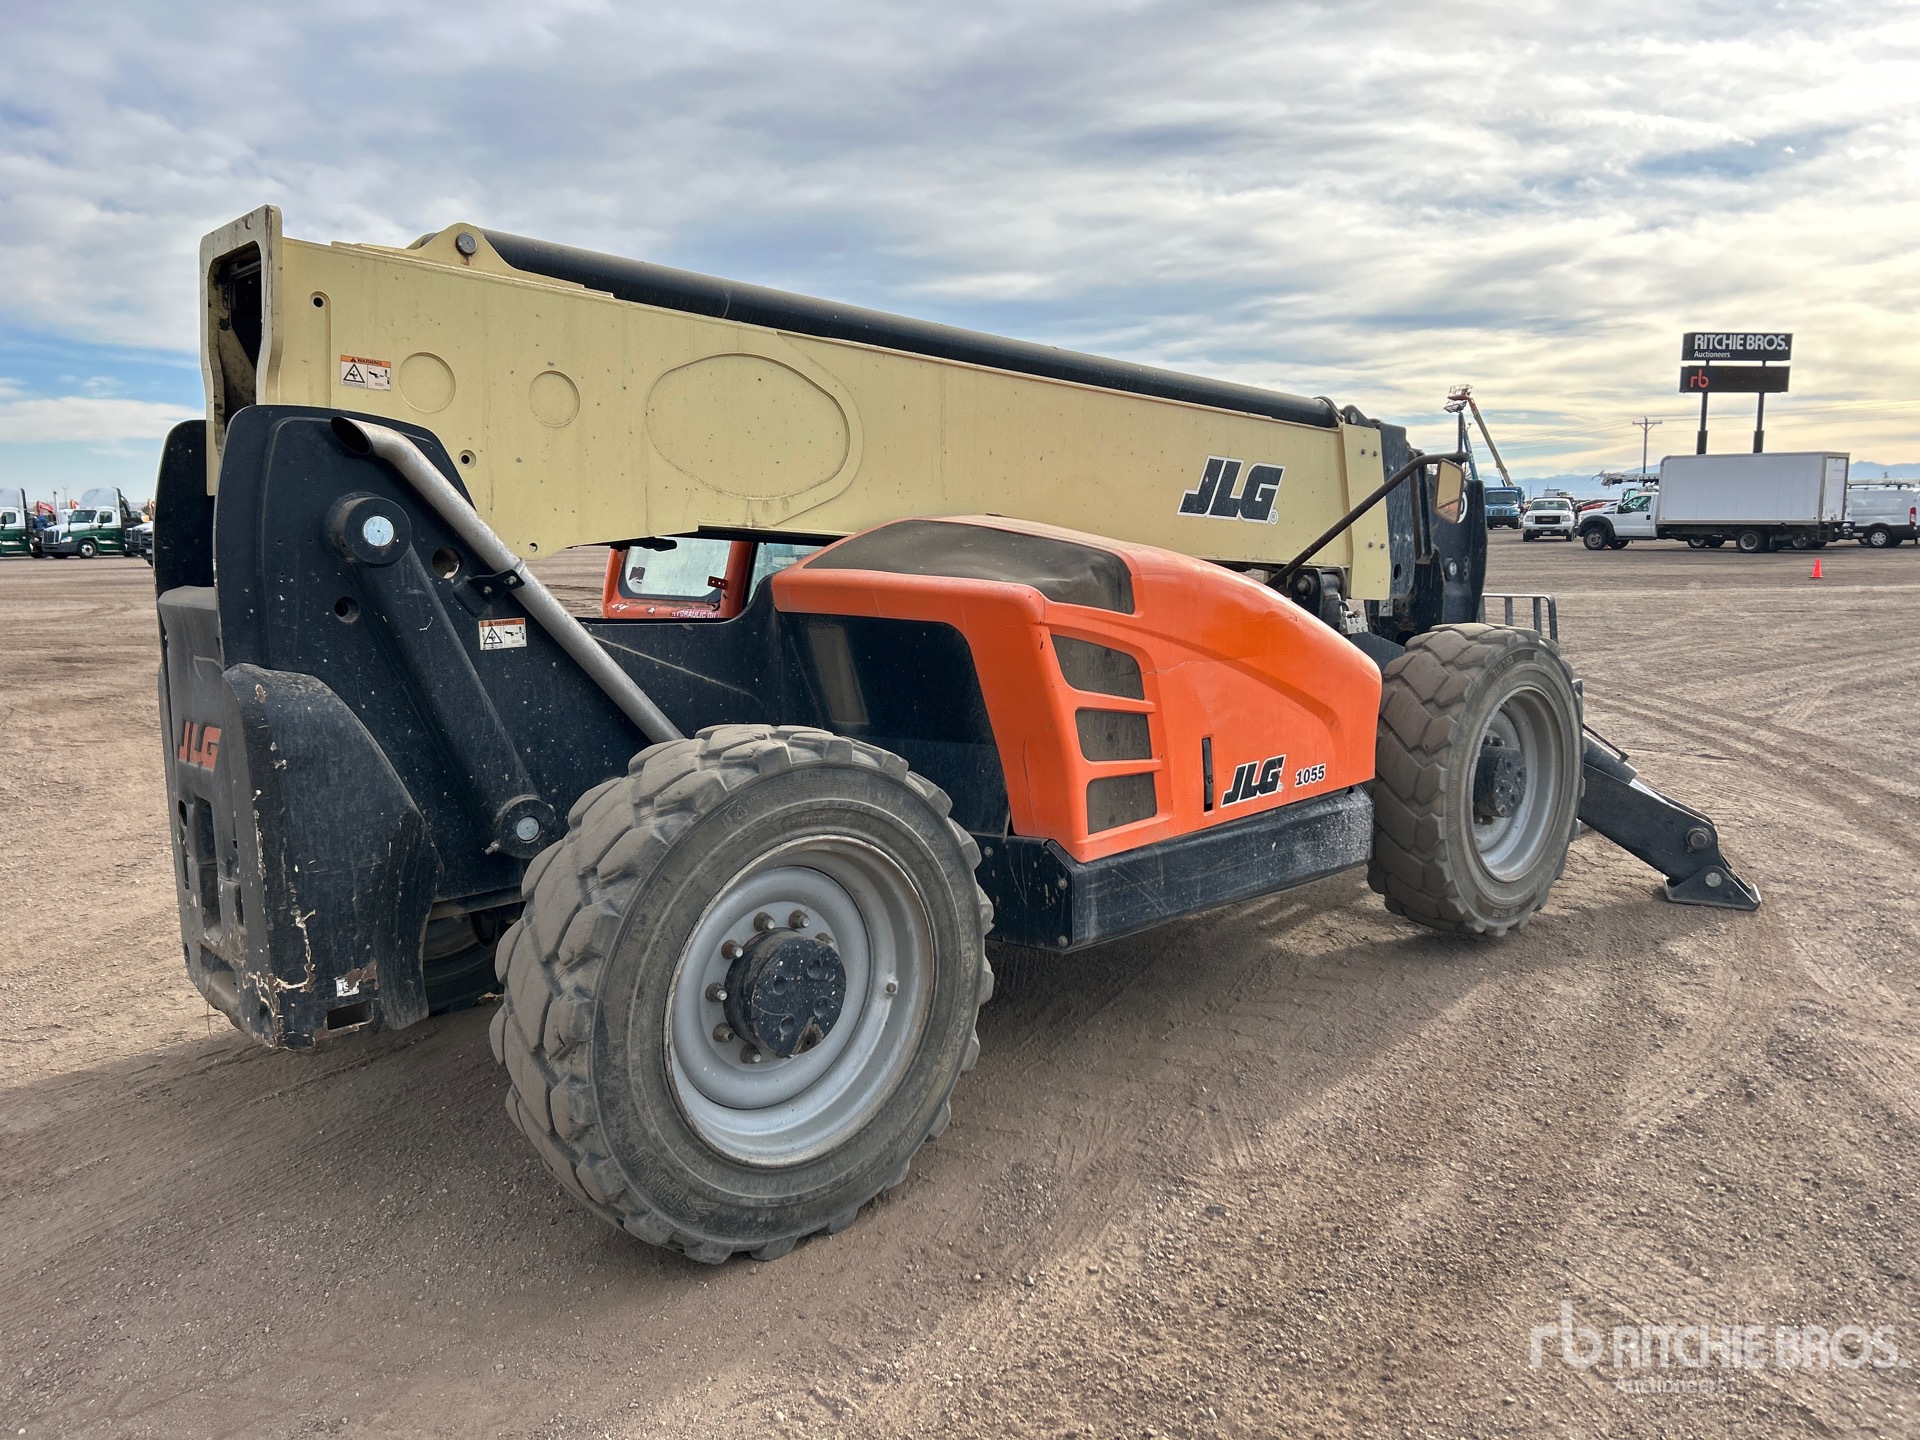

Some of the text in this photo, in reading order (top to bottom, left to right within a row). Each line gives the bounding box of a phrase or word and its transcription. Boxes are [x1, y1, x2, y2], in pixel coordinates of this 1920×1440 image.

[1693, 350, 1731, 358] Auctioneers
[1694, 334, 1789, 350] RITCHIE BROS.
[1690, 369, 1710, 388] rb
[1177, 455, 1286, 524] JLG
[178, 720, 222, 772] JLG
[1220, 753, 1326, 808] JLG 1055
